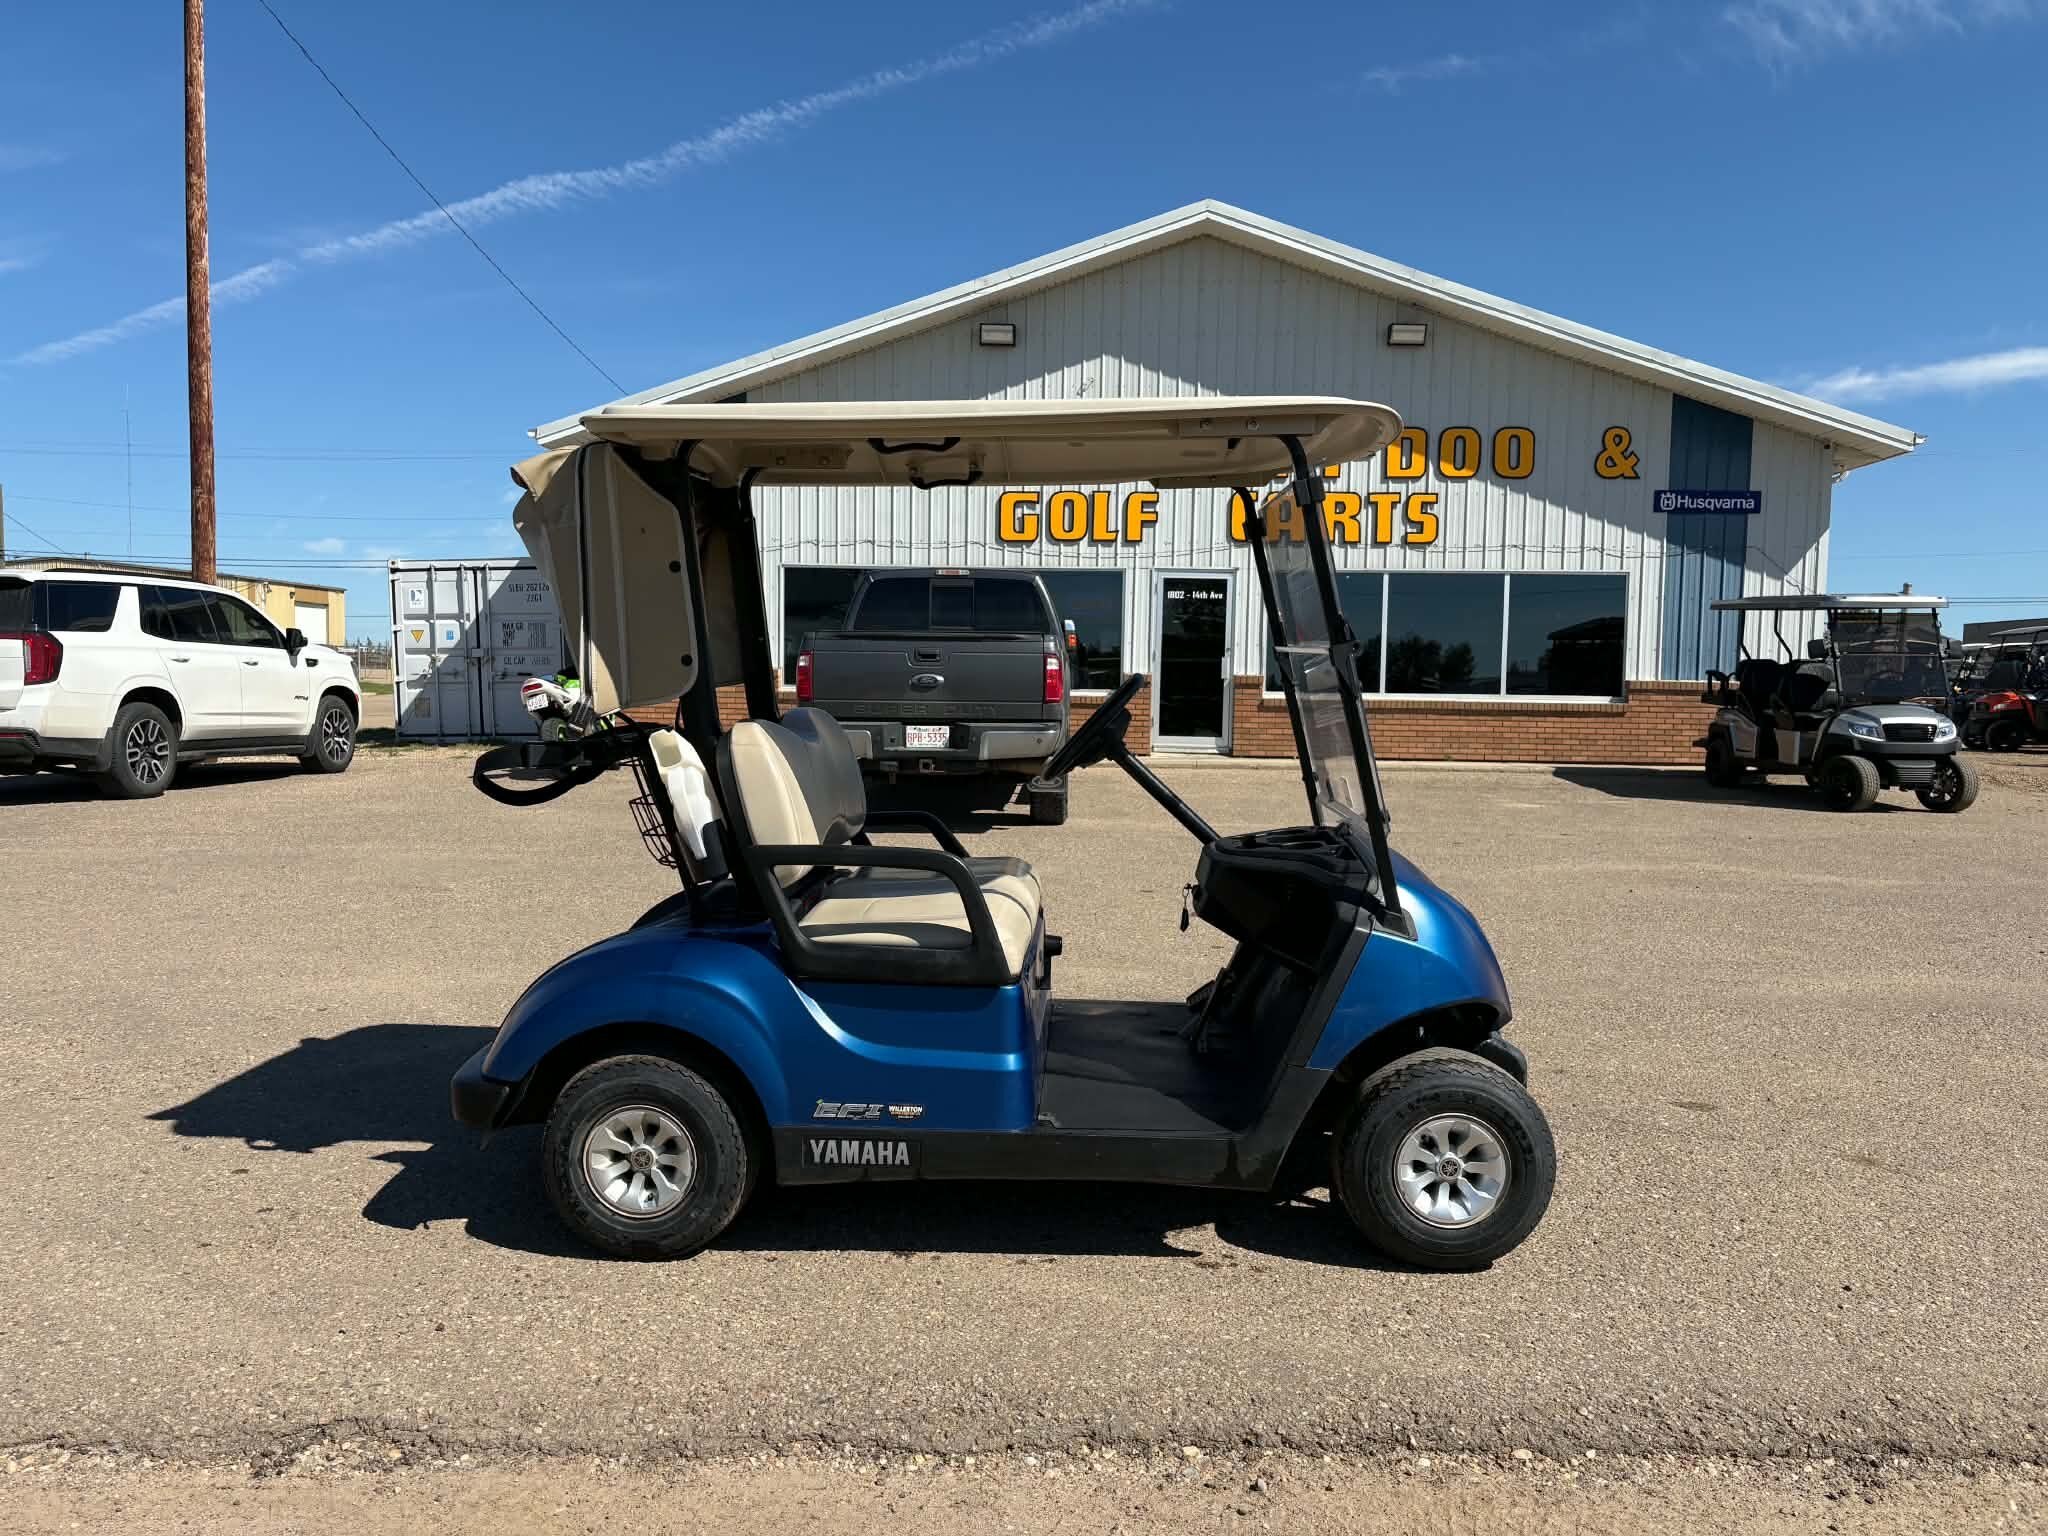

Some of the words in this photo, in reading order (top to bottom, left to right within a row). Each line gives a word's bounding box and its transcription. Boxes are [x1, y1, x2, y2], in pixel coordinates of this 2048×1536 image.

[1386, 427, 1536, 479] DOO
[1594, 426, 1641, 479] &
[999, 490, 1160, 543] GOLF
[1677, 495, 1755, 511] Husqvarna
[1167, 590, 1185, 599] 1802
[1192, 590, 1208, 599] 14th
[1210, 590, 1224, 599] Ave
[810, 1139, 910, 1166] YAMAHA
